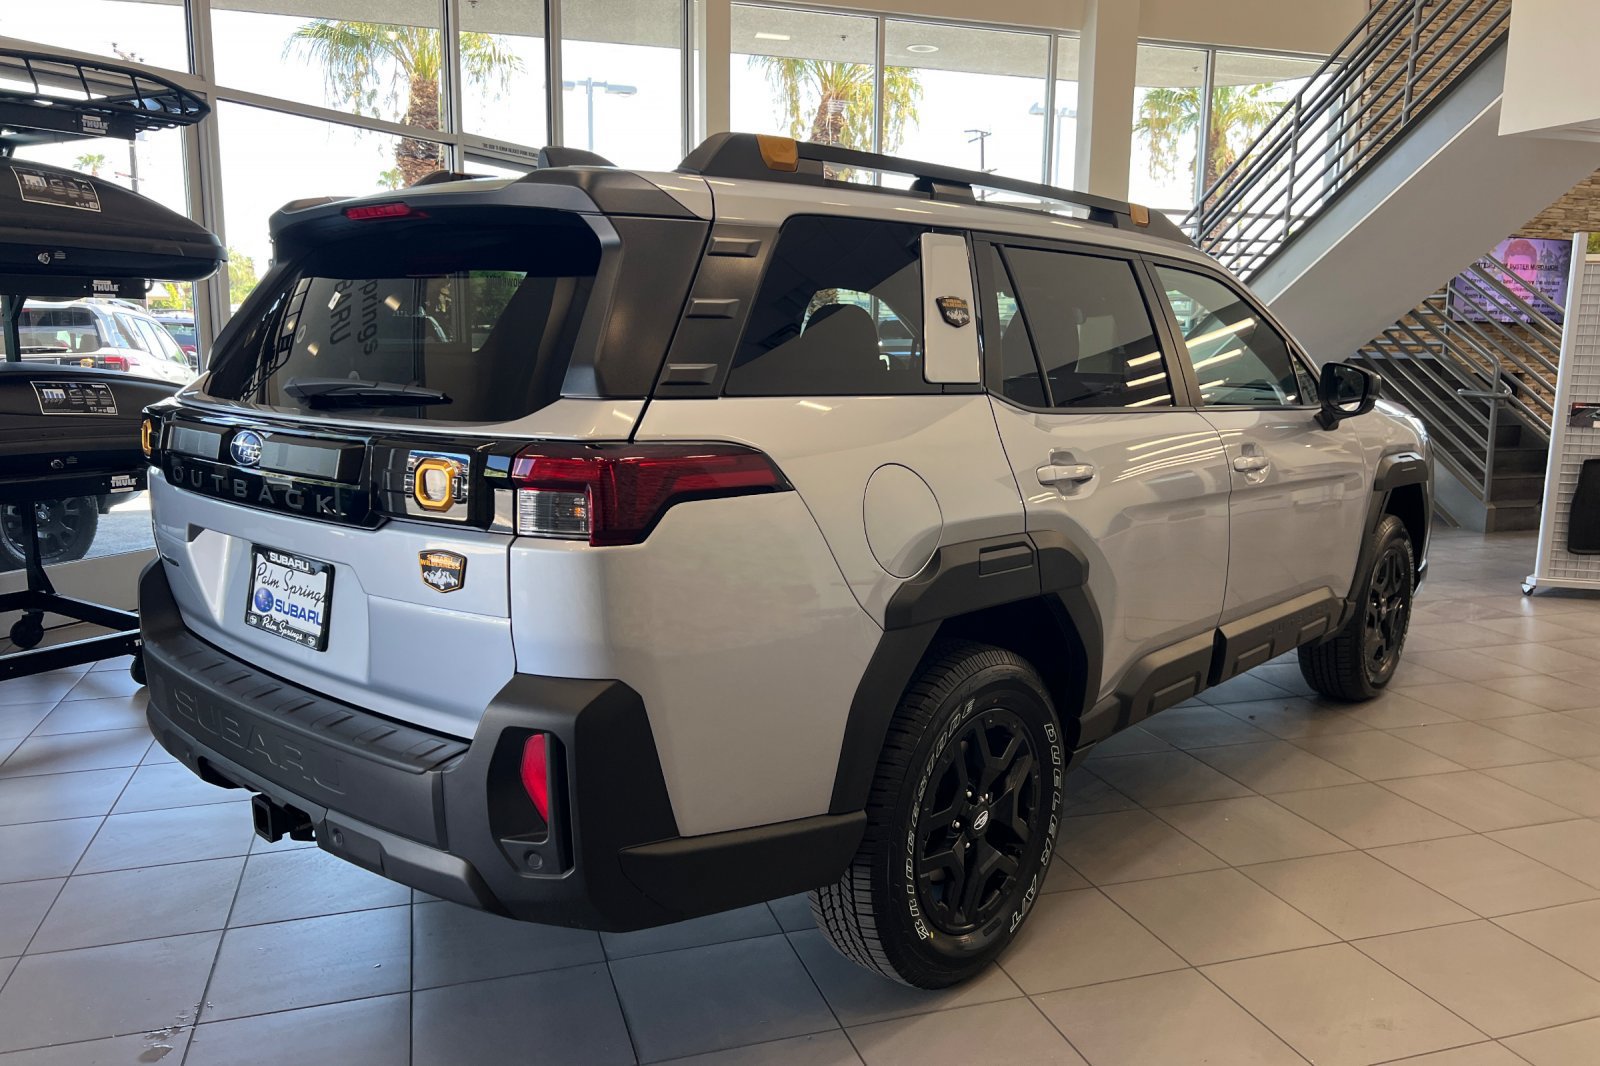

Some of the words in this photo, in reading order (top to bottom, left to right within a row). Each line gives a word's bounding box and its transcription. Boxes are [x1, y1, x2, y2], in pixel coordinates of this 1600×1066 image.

[82, 119, 109, 130] THULE
[92, 283, 119, 292] THULE
[357, 279, 382, 356] prings
[110, 477, 137, 487] THULE
[172, 465, 336, 516] OUTBACK
[255, 562, 280, 588] Palm
[269, 551, 310, 571] SUBARU
[274, 598, 323, 627] SUBARU
[262, 615, 278, 631] Palm
[278, 620, 303, 641] Springs
[174, 688, 346, 796] SUBARU
[1041, 723, 1061, 866] DUELER
[905, 698, 976, 940] BRIDGESTONE
[1009, 872, 1037, 934] A/T
